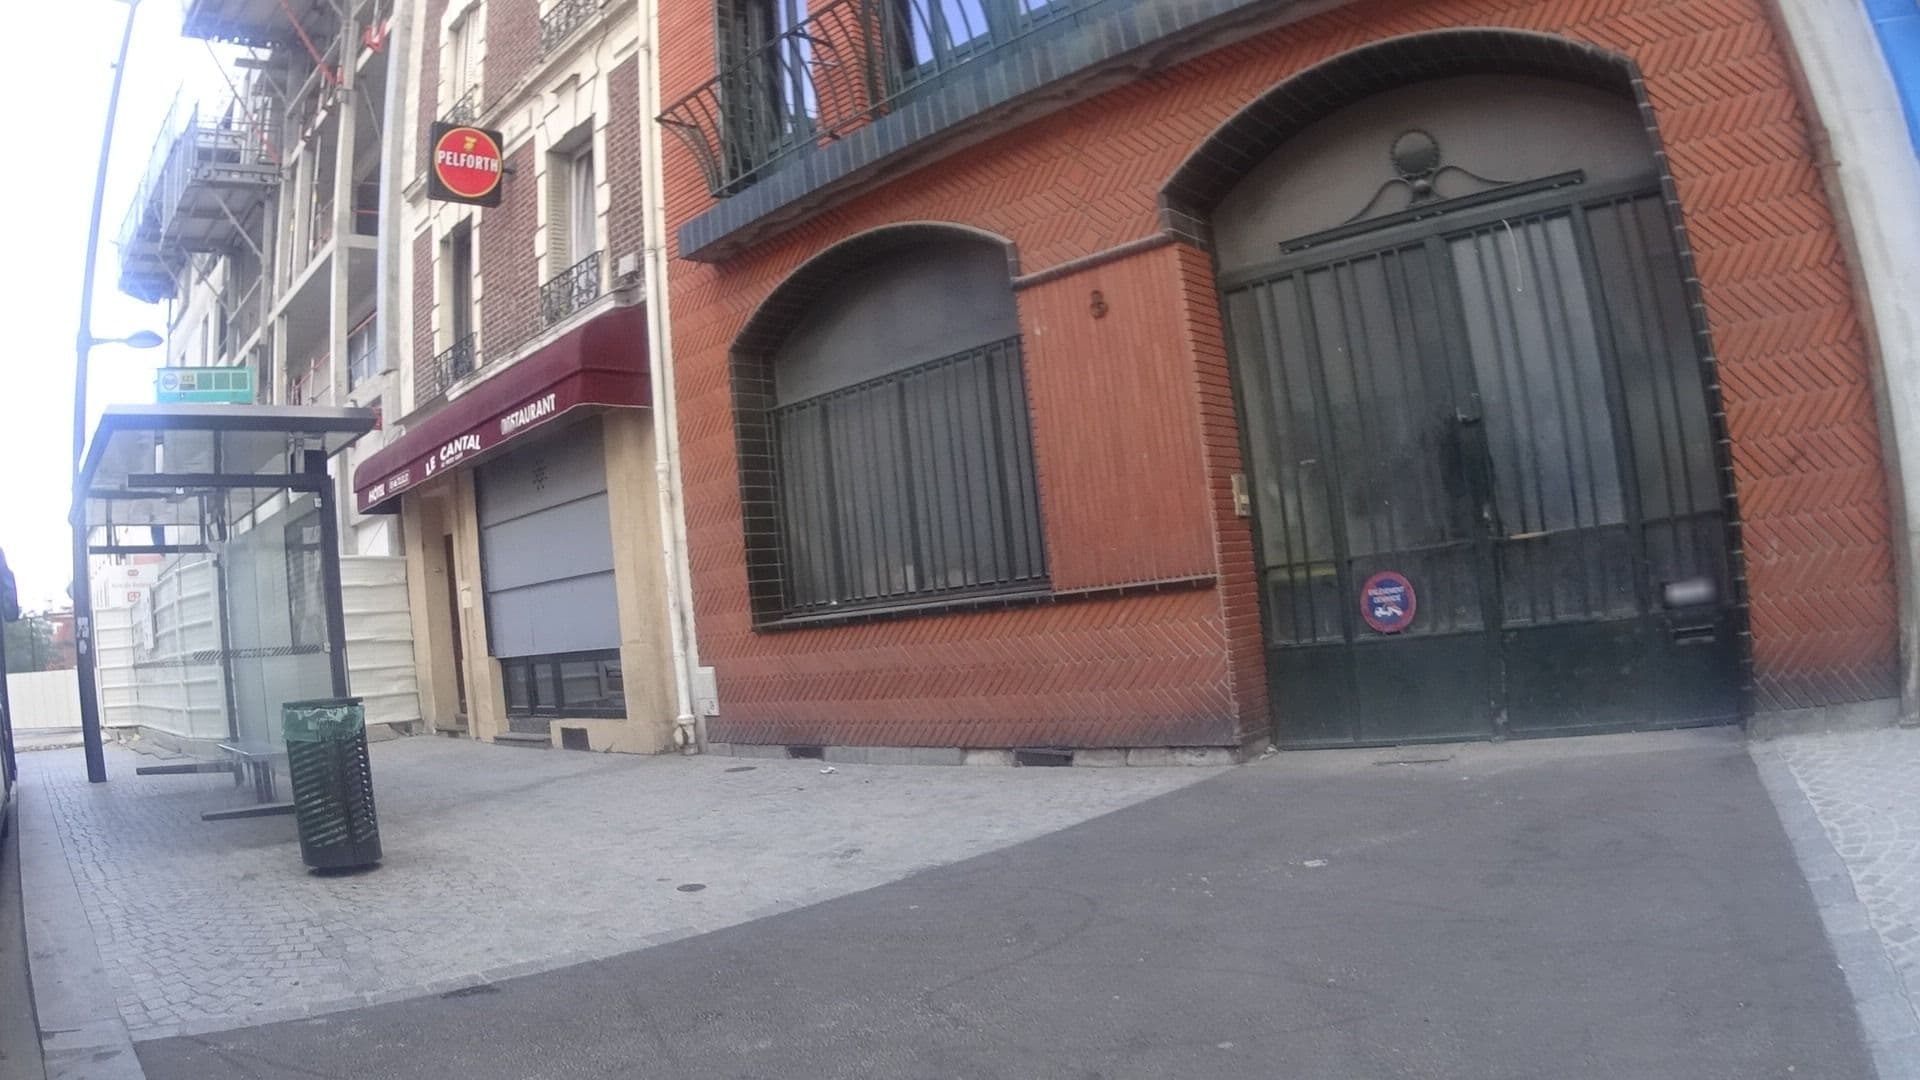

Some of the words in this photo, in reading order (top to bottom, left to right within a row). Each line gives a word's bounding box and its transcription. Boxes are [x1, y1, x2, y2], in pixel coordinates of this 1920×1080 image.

[437, 150, 498, 173] PELFORTH
[425, 455, 436, 476] LE
[440, 434, 481, 461] CANTAL
